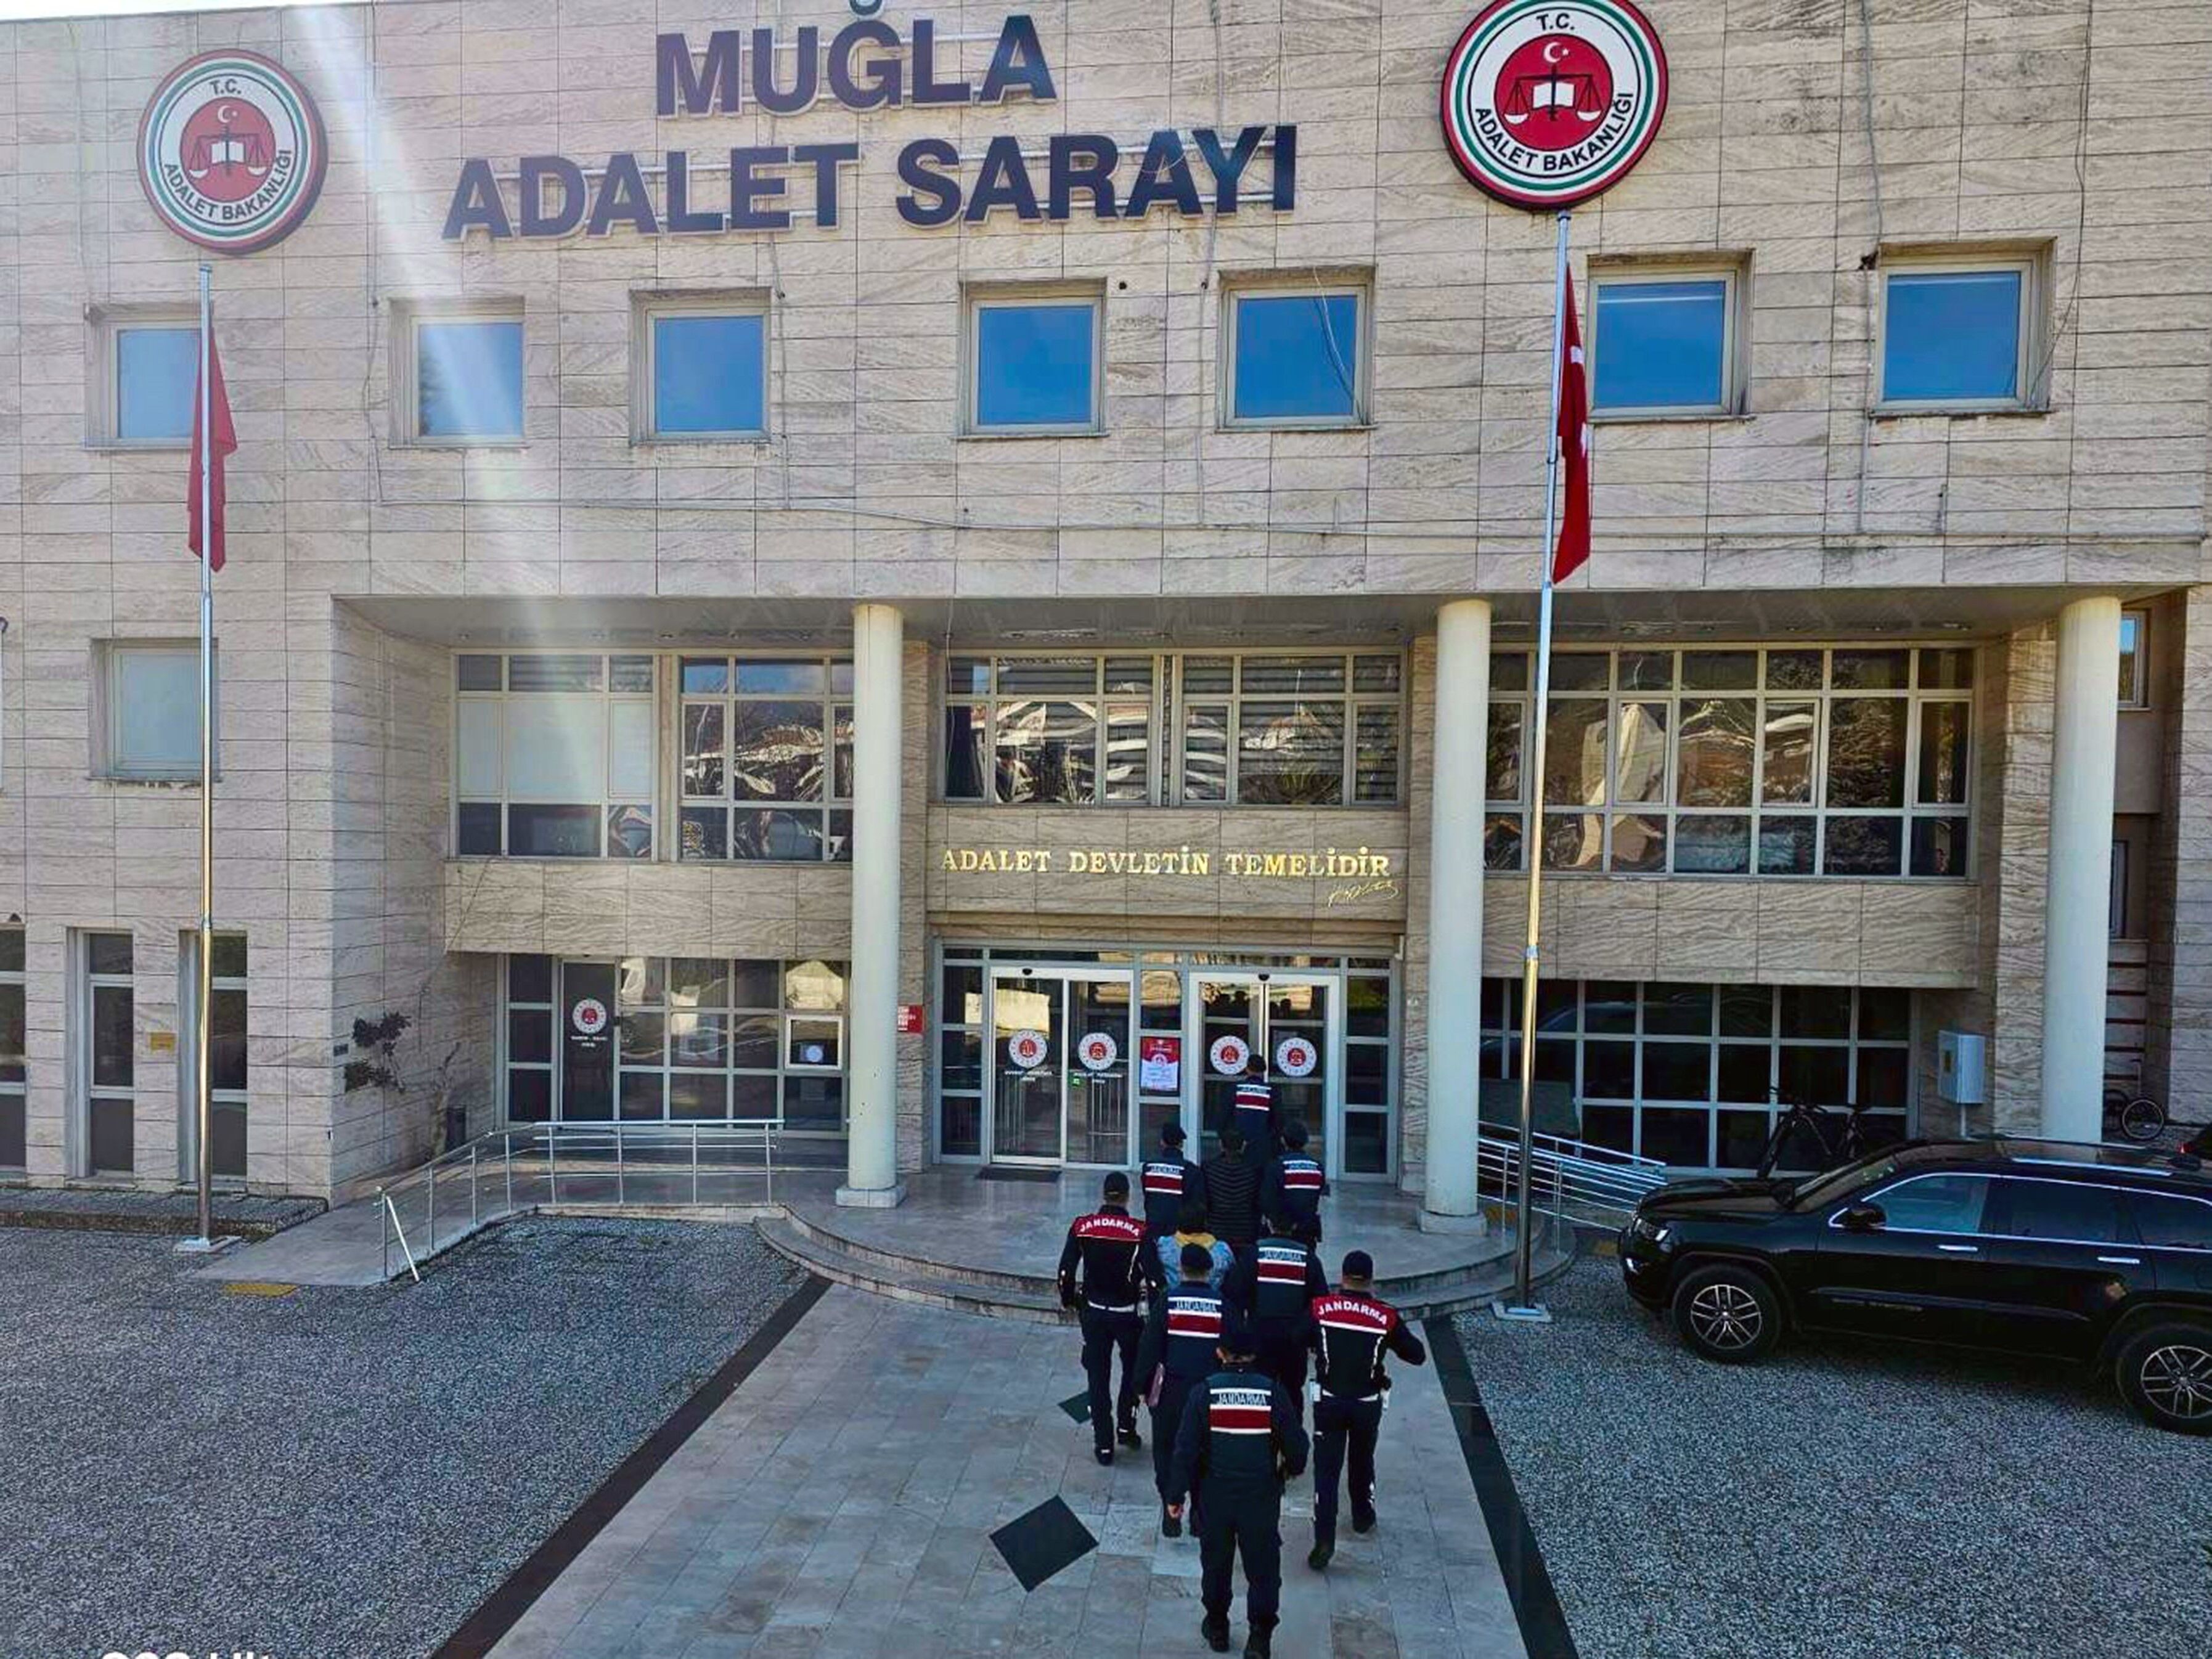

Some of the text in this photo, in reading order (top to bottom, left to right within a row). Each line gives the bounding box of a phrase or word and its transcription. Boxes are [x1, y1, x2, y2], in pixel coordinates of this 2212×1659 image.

[1537, 12, 1575, 31] T.C.
[656, 0, 1058, 116] MUĞLA
[210, 79, 242, 96] T.C.
[1475, 92, 1634, 171] ADALET BAKANLIĞI
[164, 163, 218, 218] ADALET
[441, 125, 1297, 239] ADALET SARAYI
[942, 845, 1390, 877] ADALET DEVLETİN TEMELİDİR
[1079, 1218, 1140, 1236] JANDARMA
[1318, 1300, 1387, 1324] JANDARMA
[1217, 1392, 1267, 1406] JANDARMA
